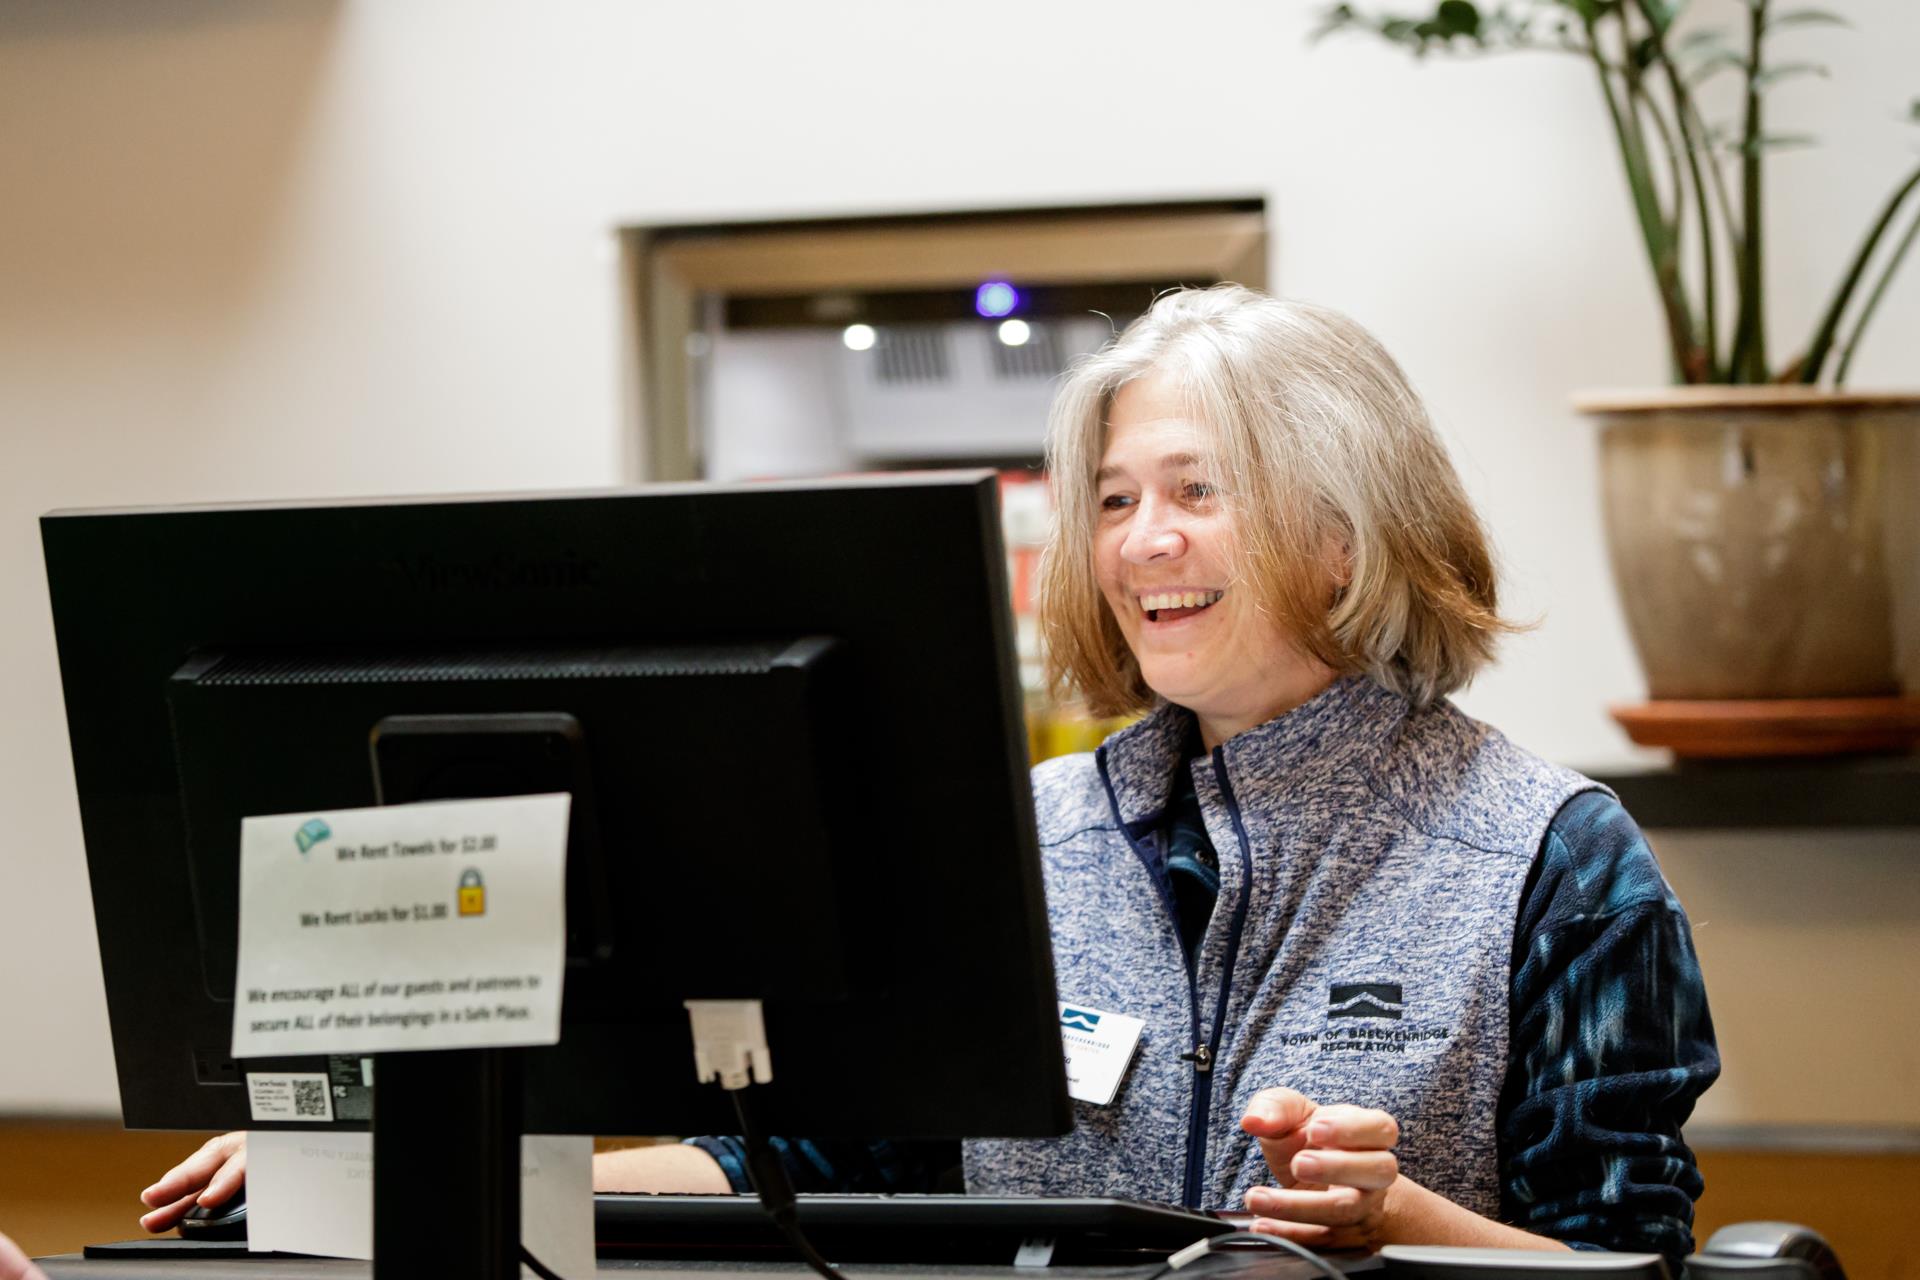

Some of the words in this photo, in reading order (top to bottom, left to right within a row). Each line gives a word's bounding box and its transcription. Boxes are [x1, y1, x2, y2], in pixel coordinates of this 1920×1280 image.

[337, 847, 356, 860] We
[361, 846, 388, 859] Rent
[394, 842, 435, 857] Towels
[440, 839, 456, 852] for
[301, 913, 319, 926] We
[325, 911, 352, 925] Rent
[356, 909, 388, 924] Locks
[393, 906, 409, 920] for
[248, 989, 266, 1002] We
[271, 987, 334, 1003] encourage
[340, 983, 359, 998] ALL
[365, 981, 377, 997] of
[381, 983, 401, 996] our
[405, 981, 444, 998] guests
[450, 977, 471, 991] and
[477, 977, 522, 994] patrons
[528, 975, 540, 988] to
[252, 1019, 289, 1032] secure
[294, 1016, 314, 1030] ALL
[319, 1014, 332, 1028] of
[336, 1012, 363, 1028] their
[369, 1011, 434, 1028] belongings
[440, 1009, 449, 1022] in
[466, 1006, 491, 1020] Safe
[1280, 1033, 1318, 1047] TOWN
[1325, 1030, 1340, 1040] OF
[1349, 1027, 1450, 1042] BRECKENRIDGE
[1320, 1041, 1407, 1054] RECREATION
